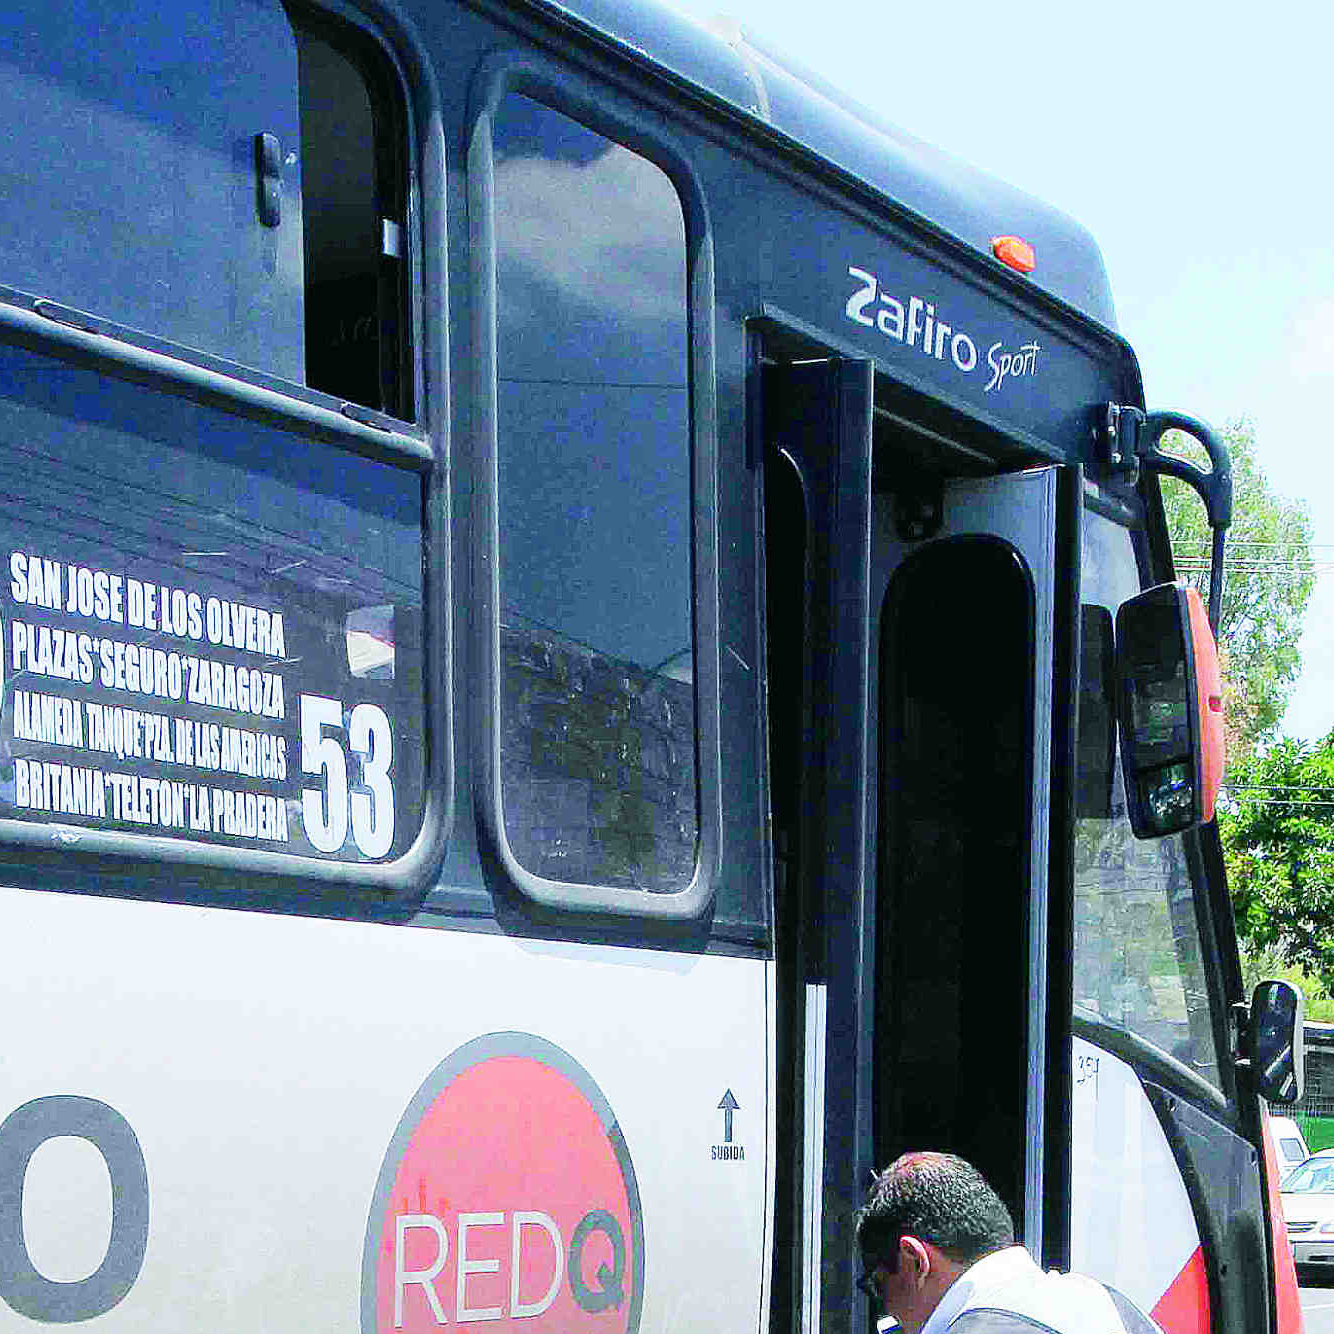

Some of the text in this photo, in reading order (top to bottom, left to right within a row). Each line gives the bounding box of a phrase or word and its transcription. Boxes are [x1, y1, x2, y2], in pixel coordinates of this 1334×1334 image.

[983, 341, 1042, 392] Sport
[9, 550, 287, 660] SAN JOSE DE LOS OLVERA
[12, 688, 85, 748] ALAMEDA
[174, 717, 195, 768] DE
[194, 721, 221, 772] LAS
[221, 726, 288, 782] AMERICAS
[298, 694, 396, 859] 53
[212, 787, 289, 842] PRADERA
[710, 1144, 746, 1161] SUBIDA
[393, 1208, 627, 1329] REDQ
